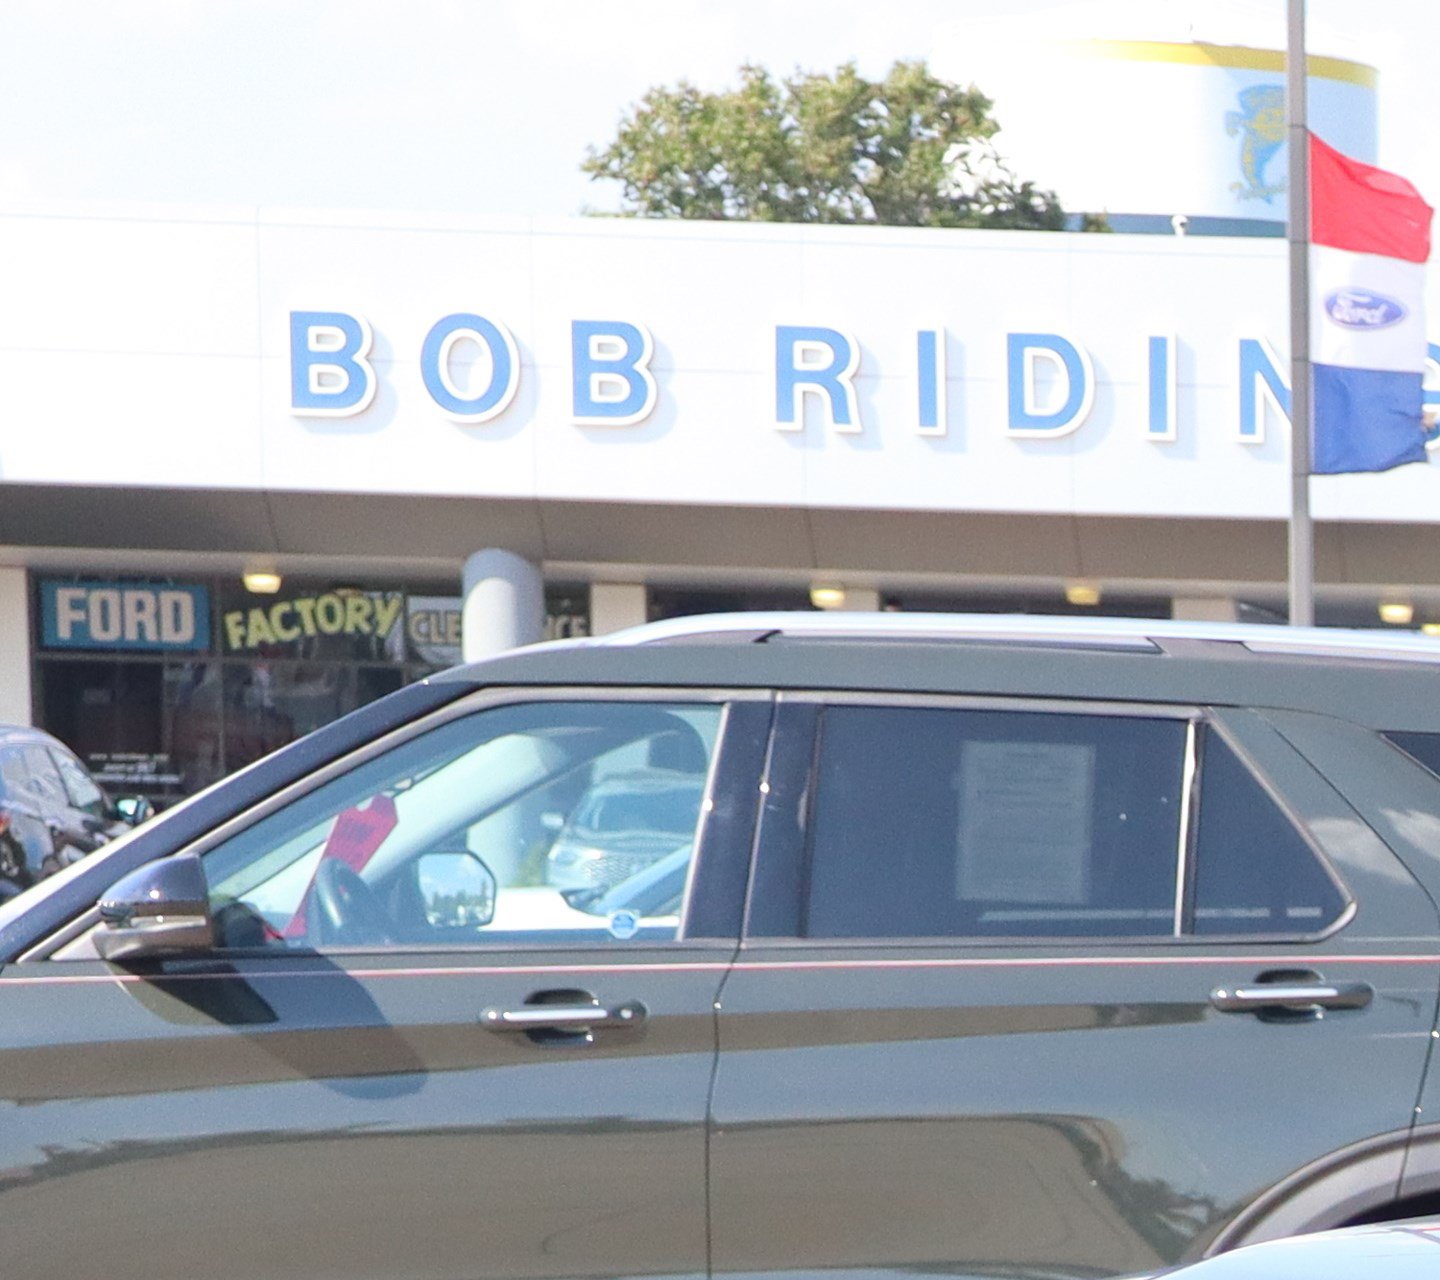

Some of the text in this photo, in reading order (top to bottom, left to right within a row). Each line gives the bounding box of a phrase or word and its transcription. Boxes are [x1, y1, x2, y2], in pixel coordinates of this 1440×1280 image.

[288, 309, 660, 426] BOB
[57, 587, 196, 642] FORD
[223, 592, 402, 651] FACTORY
